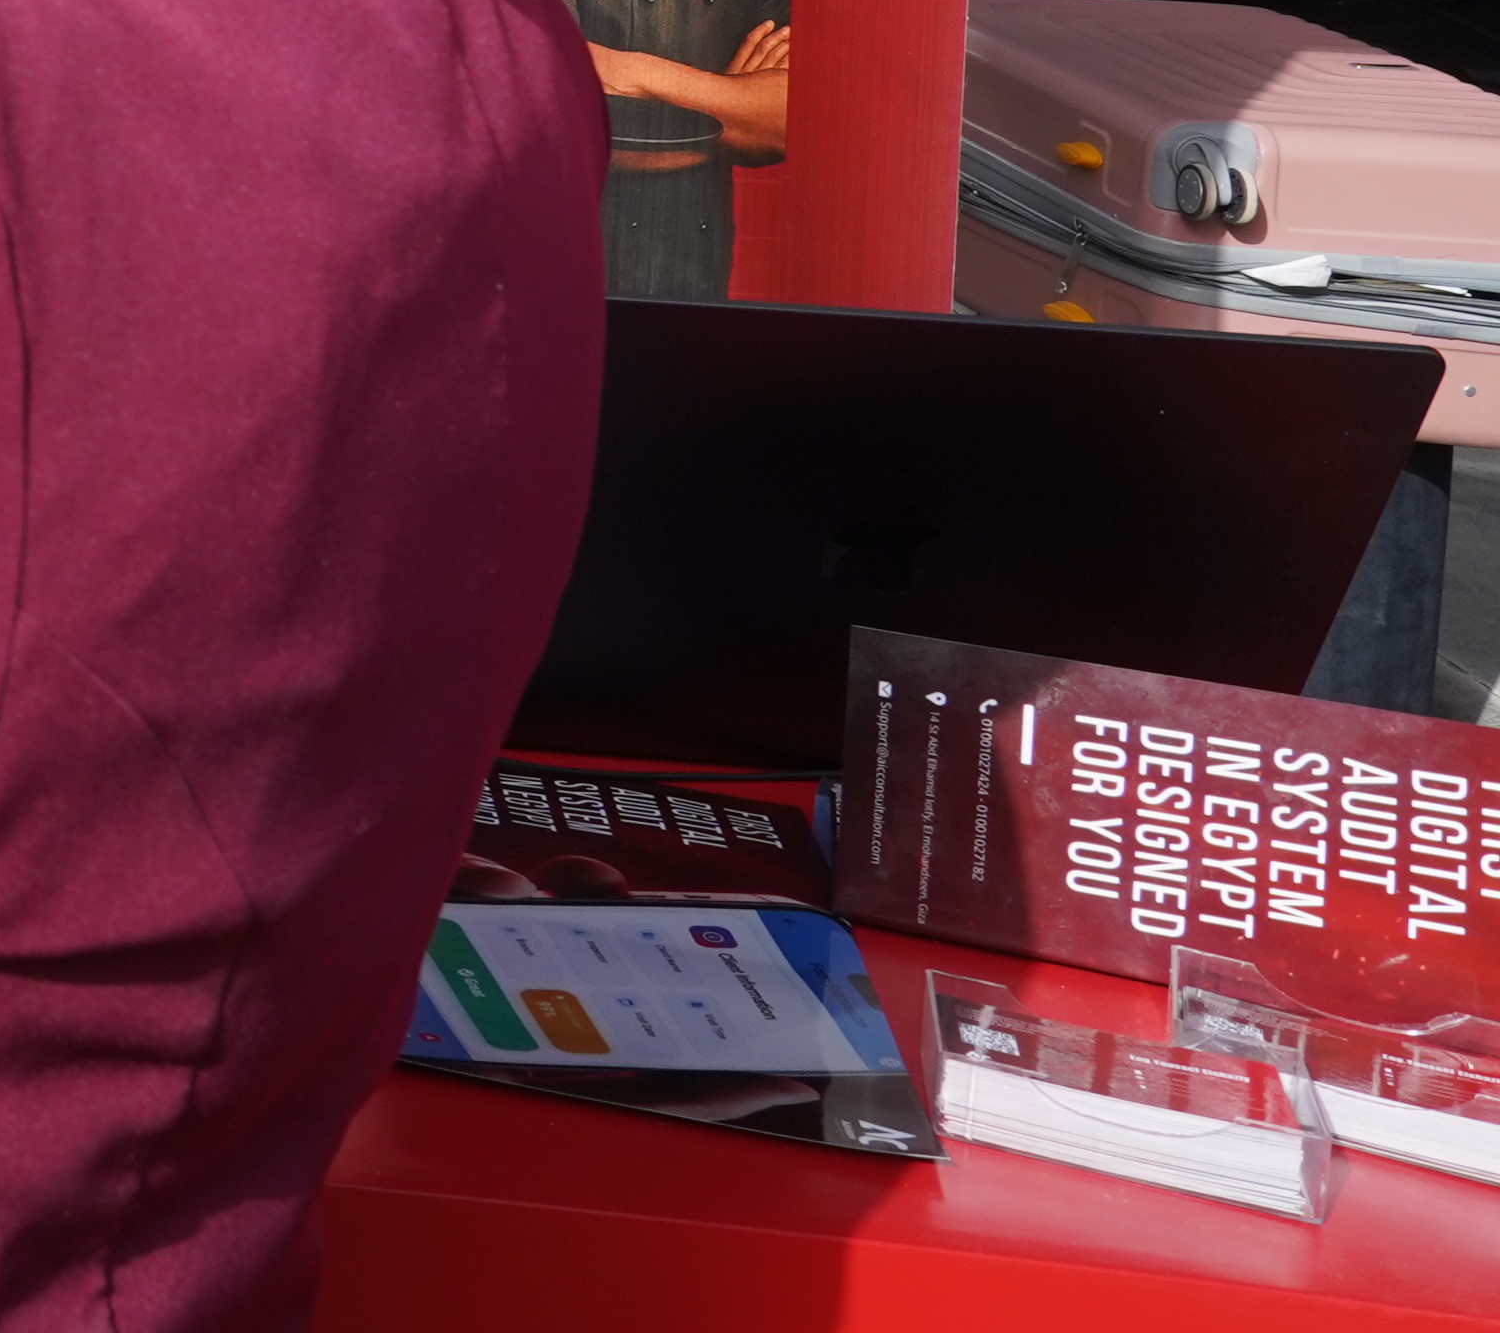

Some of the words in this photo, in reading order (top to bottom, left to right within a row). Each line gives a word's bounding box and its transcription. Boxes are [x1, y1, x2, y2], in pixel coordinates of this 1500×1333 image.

[930, 711, 941, 722] 14
[927, 736, 939, 756] Abd
[976, 718, 995, 796] 01001027424
[1071, 714, 1128, 798] FOR
[1206, 736, 1262, 783] IN
[496, 772, 544, 789] IN
[553, 779, 613, 836] SYSTEM
[499, 789, 557, 832] EGYPT
[608, 786, 667, 830] AUDIT
[666, 795, 727, 847] DIGITAL
[723, 807, 783, 849] FIRST
[1130, 725, 1195, 938] DESIGNED
[1339, 757, 1398, 894] AUDIT
[971, 804, 988, 882] 01001027182
[1065, 817, 1124, 900] YOU
[1267, 747, 1330, 928] SYSTEM
[1407, 769, 1468, 940] DIGITAL
[1198, 794, 1260, 939] EGYPT
[916, 903, 928, 925] Giza
[734, 974, 777, 1021] Information
